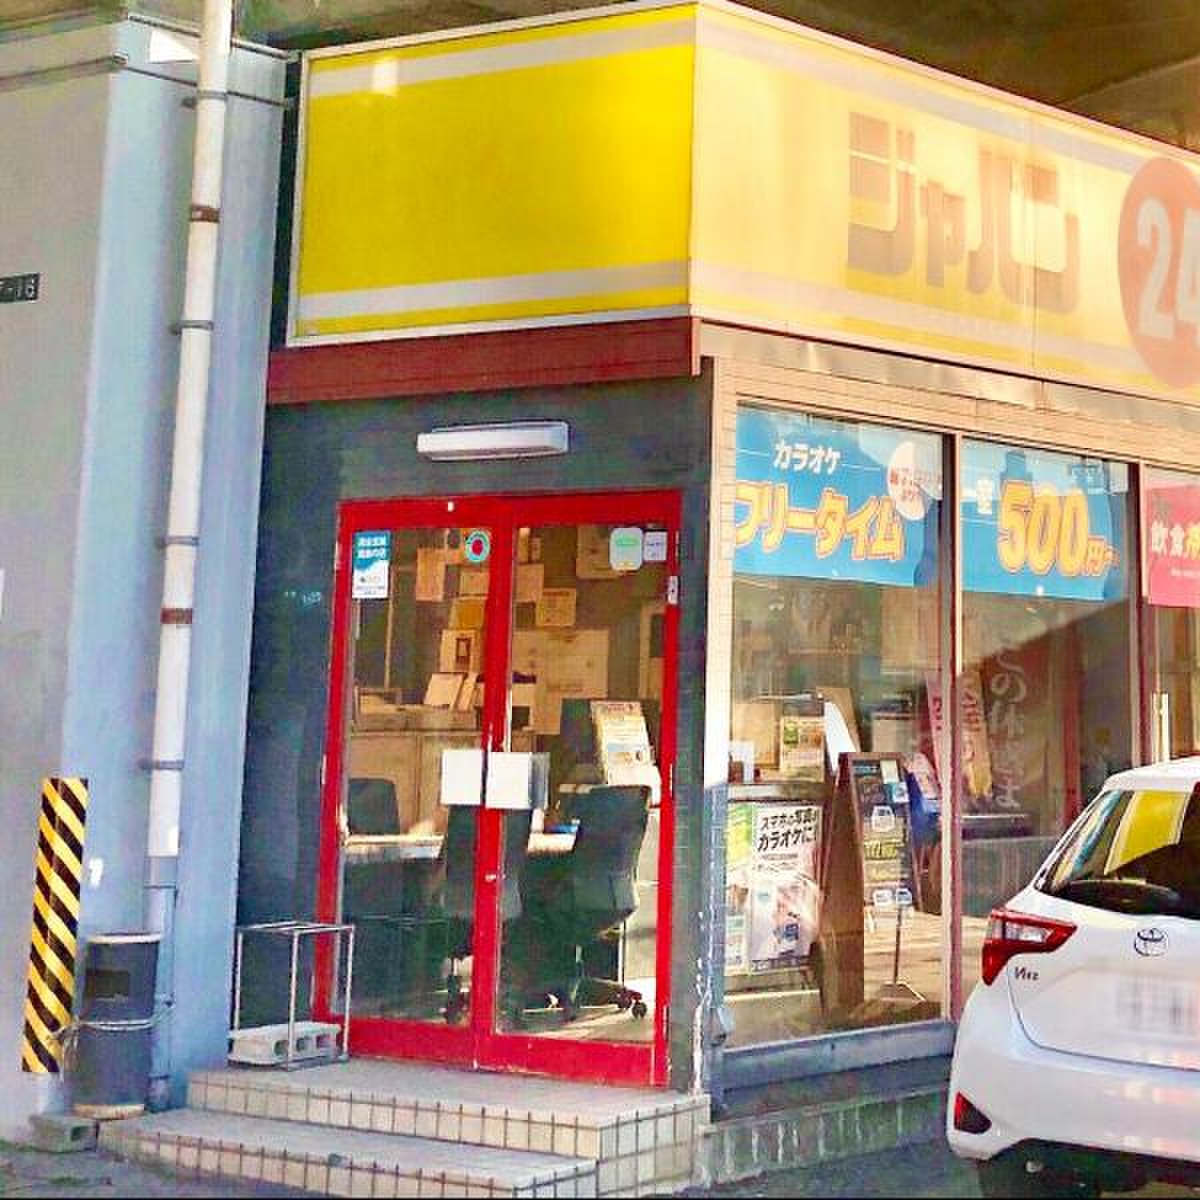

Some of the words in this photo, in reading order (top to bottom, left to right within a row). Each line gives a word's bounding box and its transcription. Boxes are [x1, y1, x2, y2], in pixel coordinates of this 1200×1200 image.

[847, 111, 1080, 315] ジャパン
[773, 438, 841, 475] カラオケ
[736, 479, 906, 563] フリータイム
